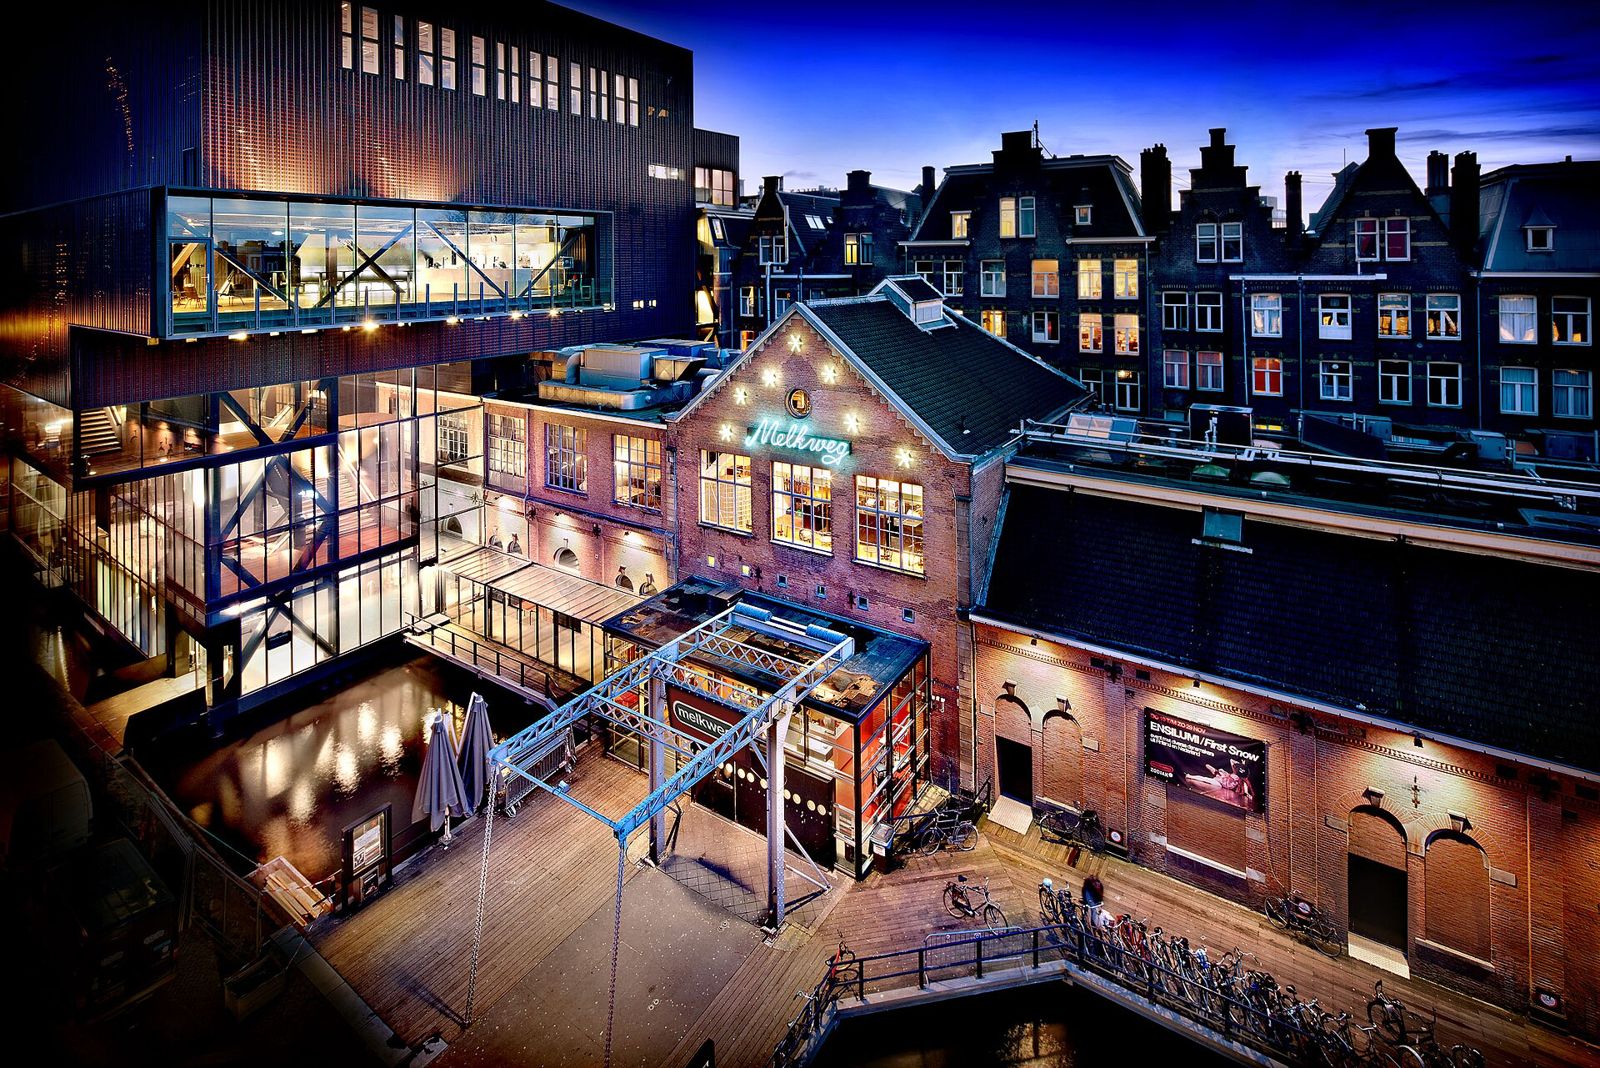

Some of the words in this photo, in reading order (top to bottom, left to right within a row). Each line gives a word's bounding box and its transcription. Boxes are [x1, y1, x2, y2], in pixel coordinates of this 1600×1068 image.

[744, 419, 849, 466] Melkweg
[1150, 720, 1200, 744] ENSILUMI
[1203, 738, 1227, 753] First
[1228, 745, 1259, 762] Snow
